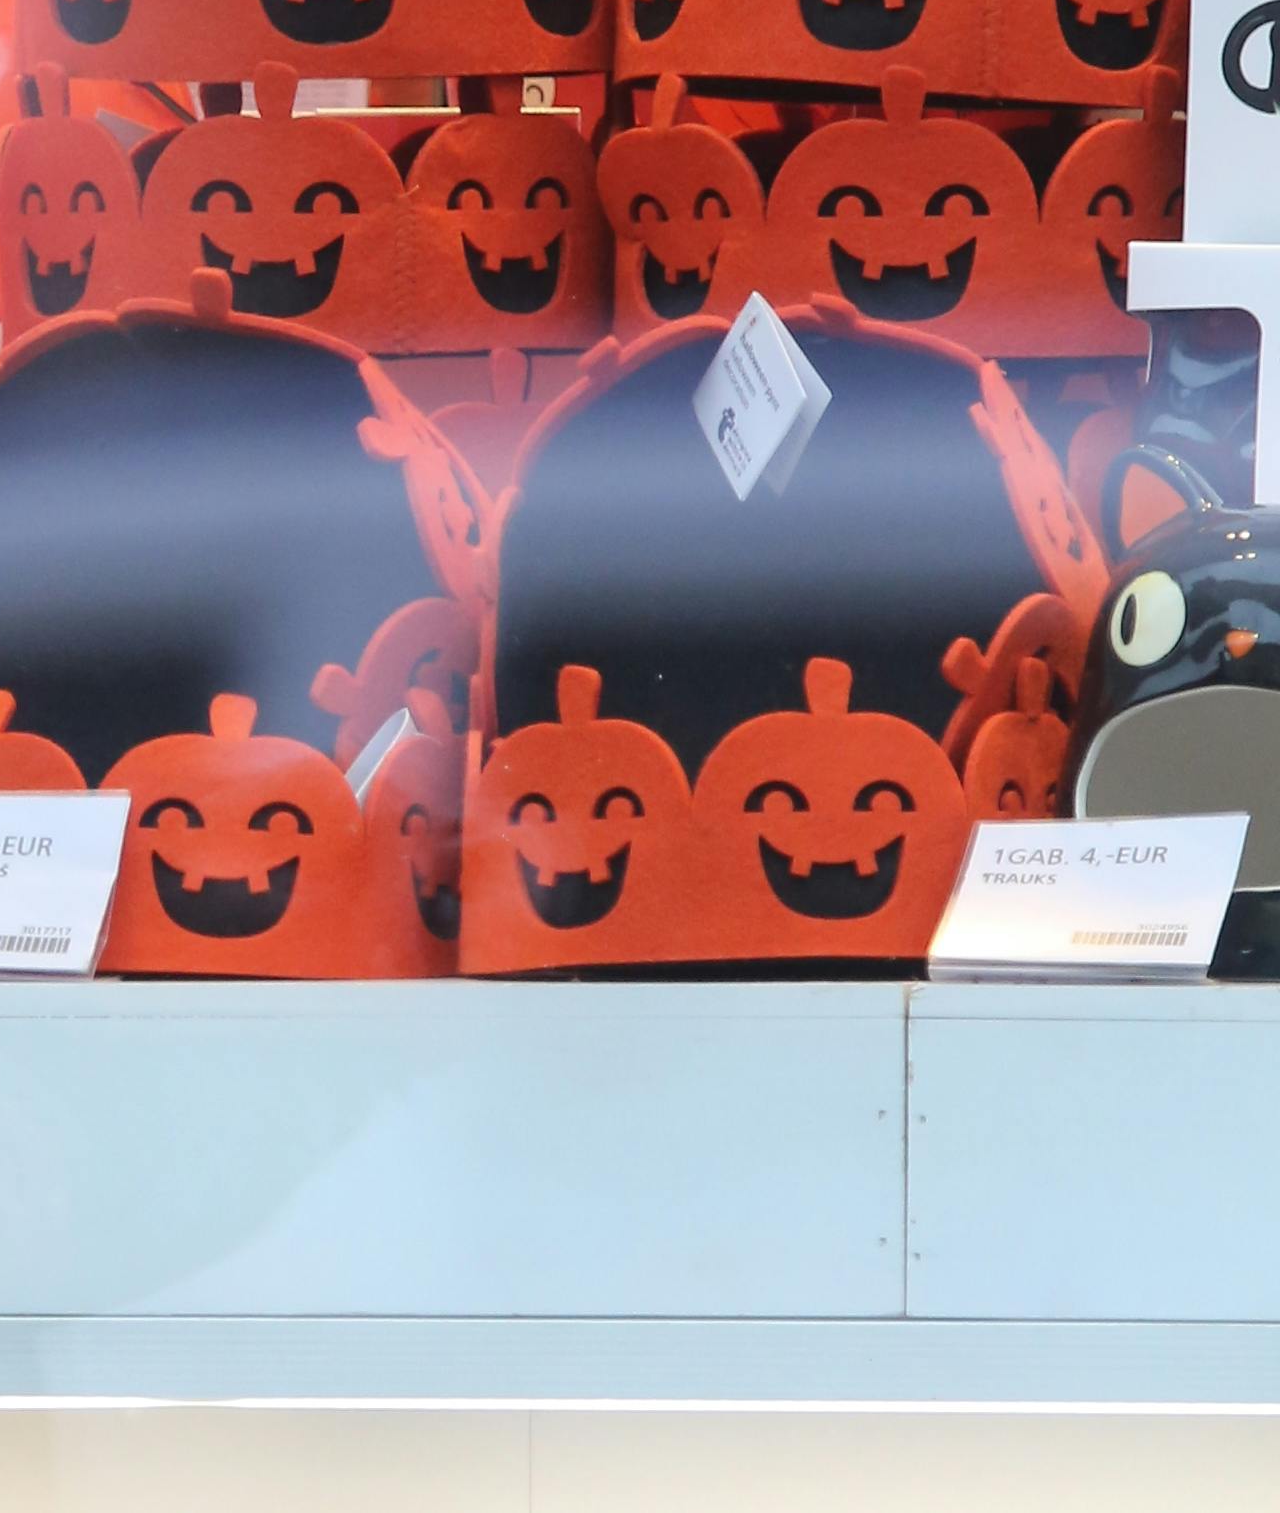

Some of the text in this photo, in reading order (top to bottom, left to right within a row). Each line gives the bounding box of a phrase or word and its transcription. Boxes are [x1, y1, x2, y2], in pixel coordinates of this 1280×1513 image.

[993, 846, 1168, 867] 1GAB. 4,-EUR
[982, 873, 1057, 885] TRAUKS
